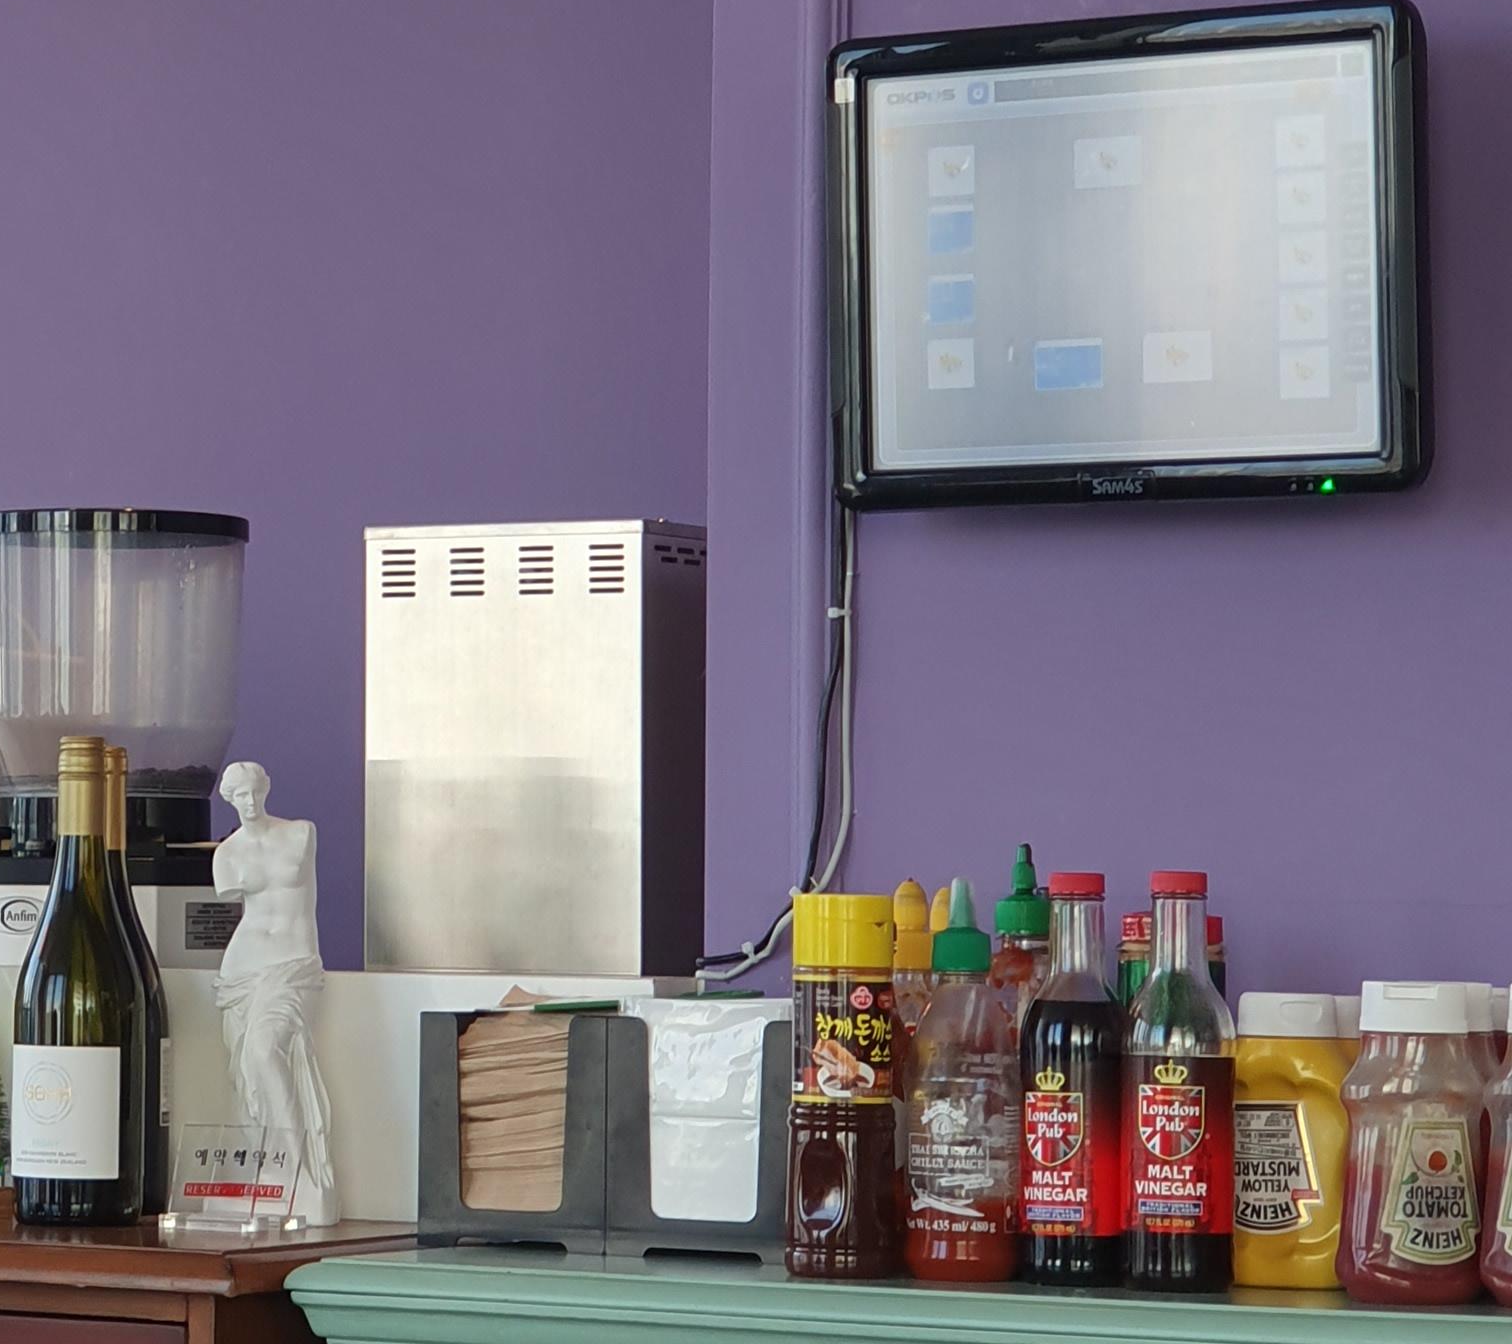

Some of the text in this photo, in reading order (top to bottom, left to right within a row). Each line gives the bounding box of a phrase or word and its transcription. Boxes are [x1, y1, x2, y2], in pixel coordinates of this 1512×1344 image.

[5, 911, 38, 922] Anfim
[1028, 1108, 1078, 1123] London
[1142, 1100, 1200, 1117] London
[1037, 1123, 1063, 1139] Pub
[1155, 1116, 1184, 1132] Pub
[947, 1157, 985, 1170] SAUCE
[1234, 1161, 1301, 1177] MUSTARD
[1031, 1171, 1073, 1186] MALT
[1147, 1164, 1194, 1180] MALT
[1024, 1186, 1088, 1202] VINEGAR
[1135, 1180, 1208, 1197] VINEGAR
[1241, 1179, 1291, 1193] YELLOW
[1405, 1185, 1466, 1200] KETCHUP
[1239, 1200, 1294, 1221] HEINZ
[1402, 1199, 1469, 1218] TOMATO
[932, 1220, 950, 1232] 435
[1409, 1227, 1463, 1250] HEINZ
